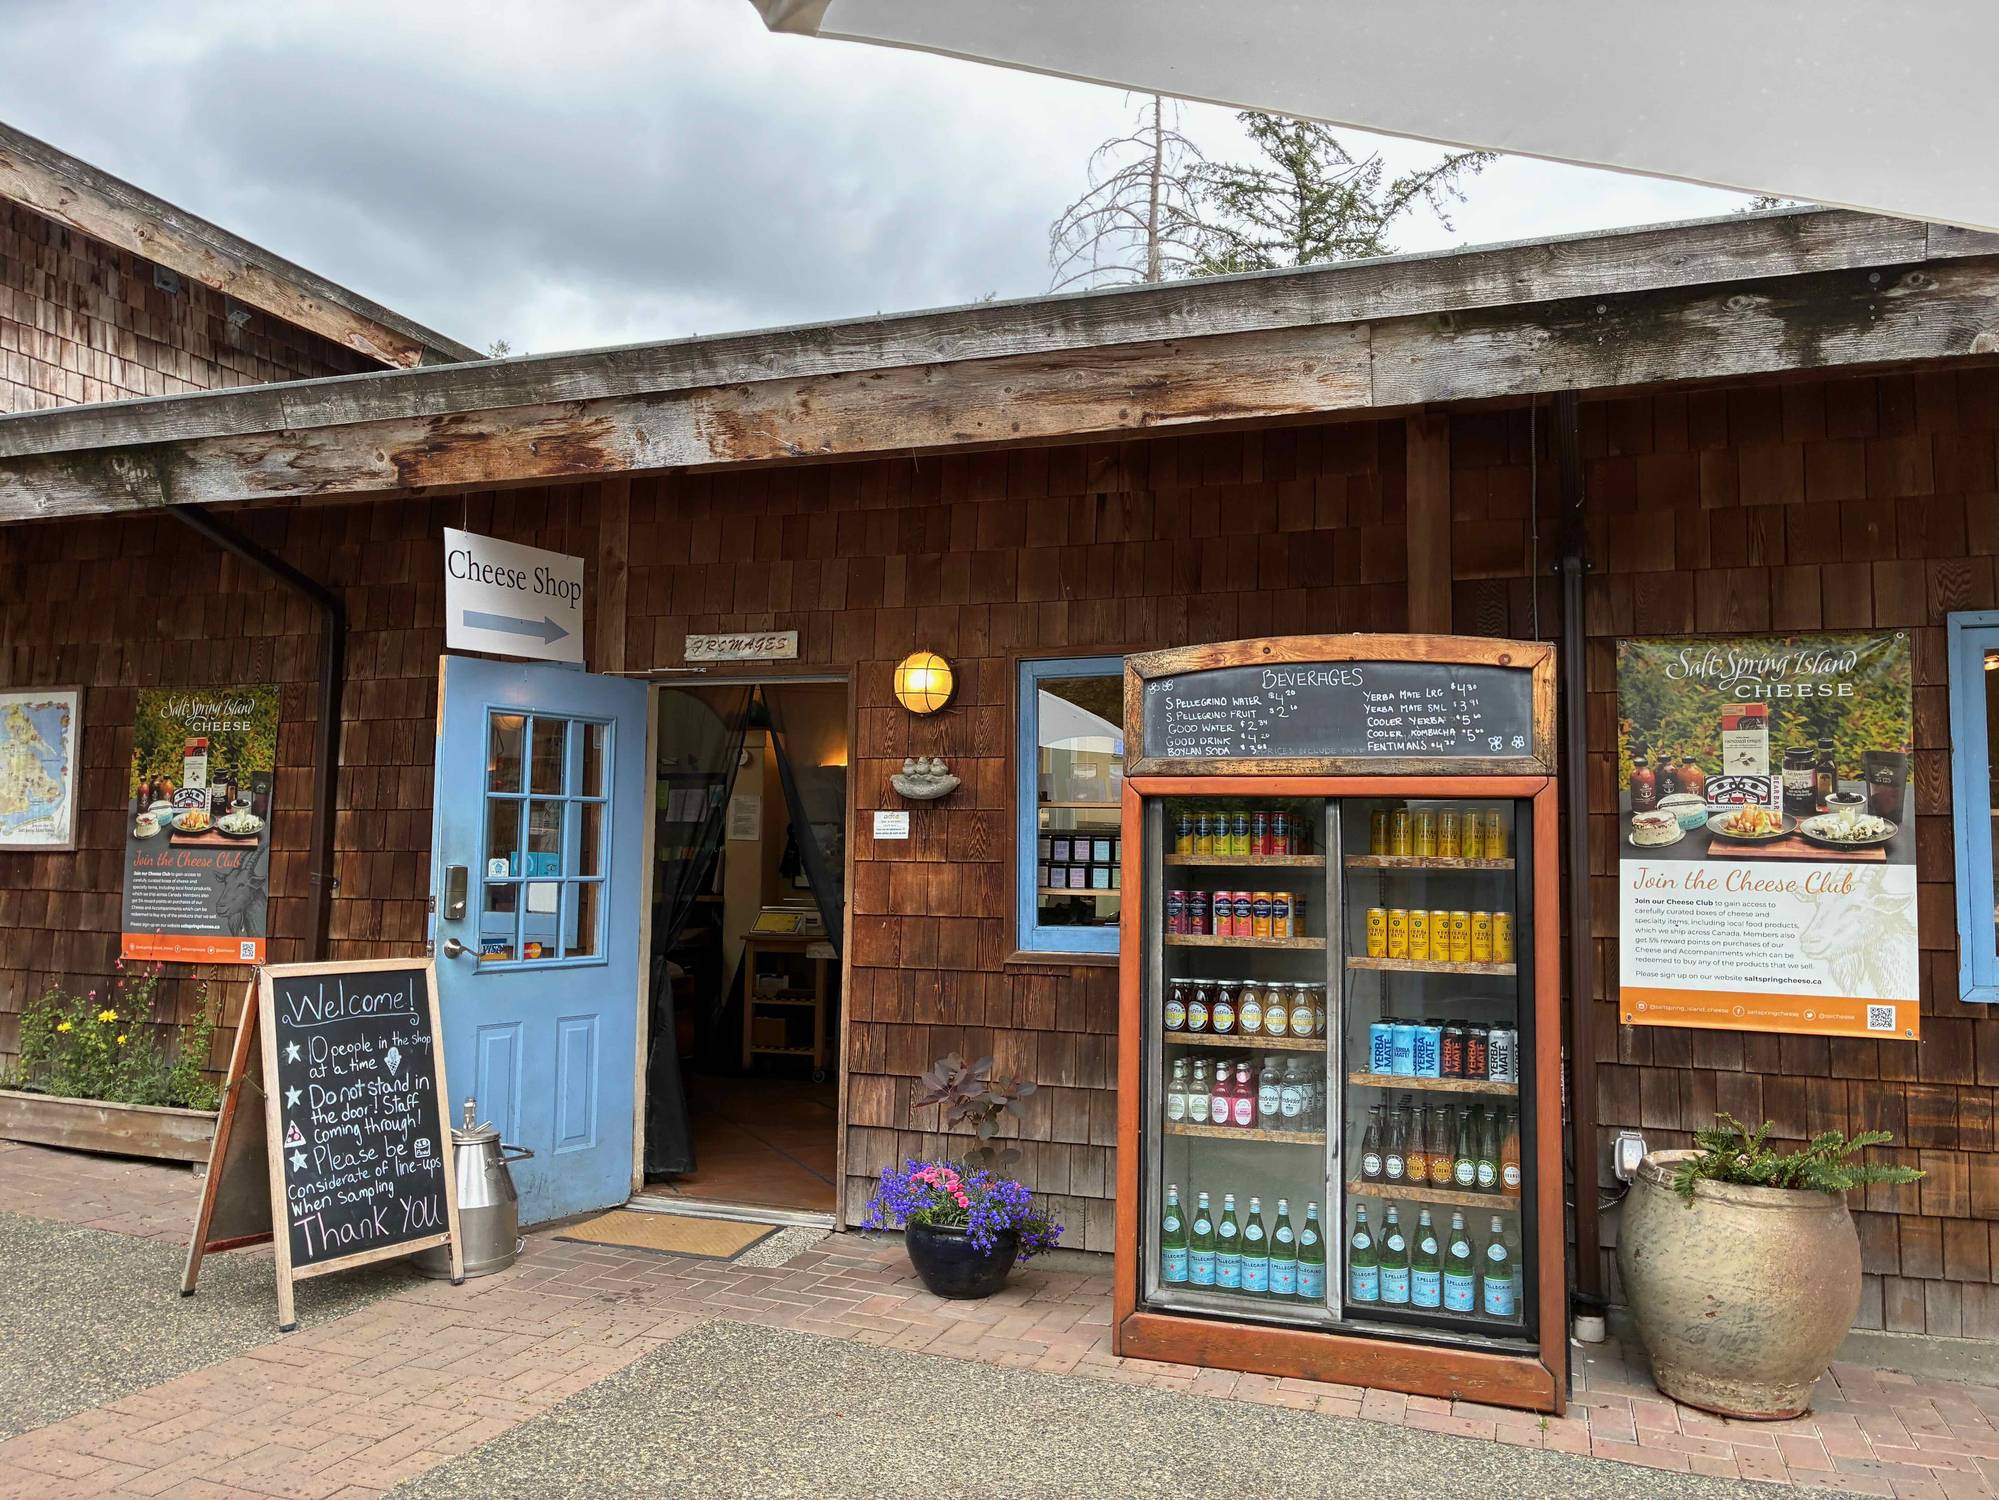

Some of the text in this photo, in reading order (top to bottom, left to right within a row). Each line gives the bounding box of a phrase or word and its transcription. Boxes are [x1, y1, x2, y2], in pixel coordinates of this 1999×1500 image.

[448, 550, 582, 609] Cheese Shop
[1666, 647, 1857, 690] Salt Spring Island
[1262, 669, 1363, 689] BEVERAGES
[1363, 691, 1394, 701] YERBA
[1400, 690, 1420, 699] MATE
[1426, 688, 1444, 697] LRG
[1735, 683, 1854, 698] CHEESE
[161, 696, 255, 726] Salt Spring Island
[1177, 698, 1227, 709] PELLEGRINO
[1233, 696, 1262, 706] WATER
[1364, 704, 1393, 714] YERBA
[1401, 704, 1422, 712] MATE
[1428, 704, 1447, 712] SML
[1177, 710, 1226, 720] PELLEGRINO
[1230, 710, 1256, 718] FRUIT
[1368, 717, 1402, 726] COOLER
[1409, 717, 1445, 725] YERBA
[193, 722, 251, 731] CHEESE
[1169, 724, 1197, 734] GOOD
[1202, 724, 1235, 732] WATER
[1368, 729, 1402, 738] COOLER
[1411, 728, 1455, 737] KOMBUCHA
[1166, 736, 1195, 746] GOOD
[1368, 740, 1427, 751] FENTIMANS
[1168, 746, 1201, 756] BOYLAN
[1206, 746, 1230, 755] SODA
[134, 848, 240, 868] Join the Cheese Club
[1633, 867, 1855, 895] Join the Cheese Club
[1736, 960, 1769, 968] products
[1660, 971, 1675, 979] sign
[286, 978, 414, 1021] Welcome!
[308, 1036, 327, 1065] 10
[331, 1033, 374, 1068] people
[379, 1036, 388, 1049] in
[392, 1031, 409, 1045] the
[1375, 1035, 1384, 1069] YERBA
[1426, 1041, 1434, 1070] MATE
[310, 1063, 327, 1078] at
[350, 1058, 378, 1072] time
[1499, 1045, 1507, 1075] MATE
[368, 1072, 409, 1096] stand
[415, 1075, 429, 1091] in
[311, 1108, 338, 1125] the
[383, 1092, 419, 1115] Staff
[313, 1135, 408, 1174] Please be
[375, 1161, 388, 1177] of
